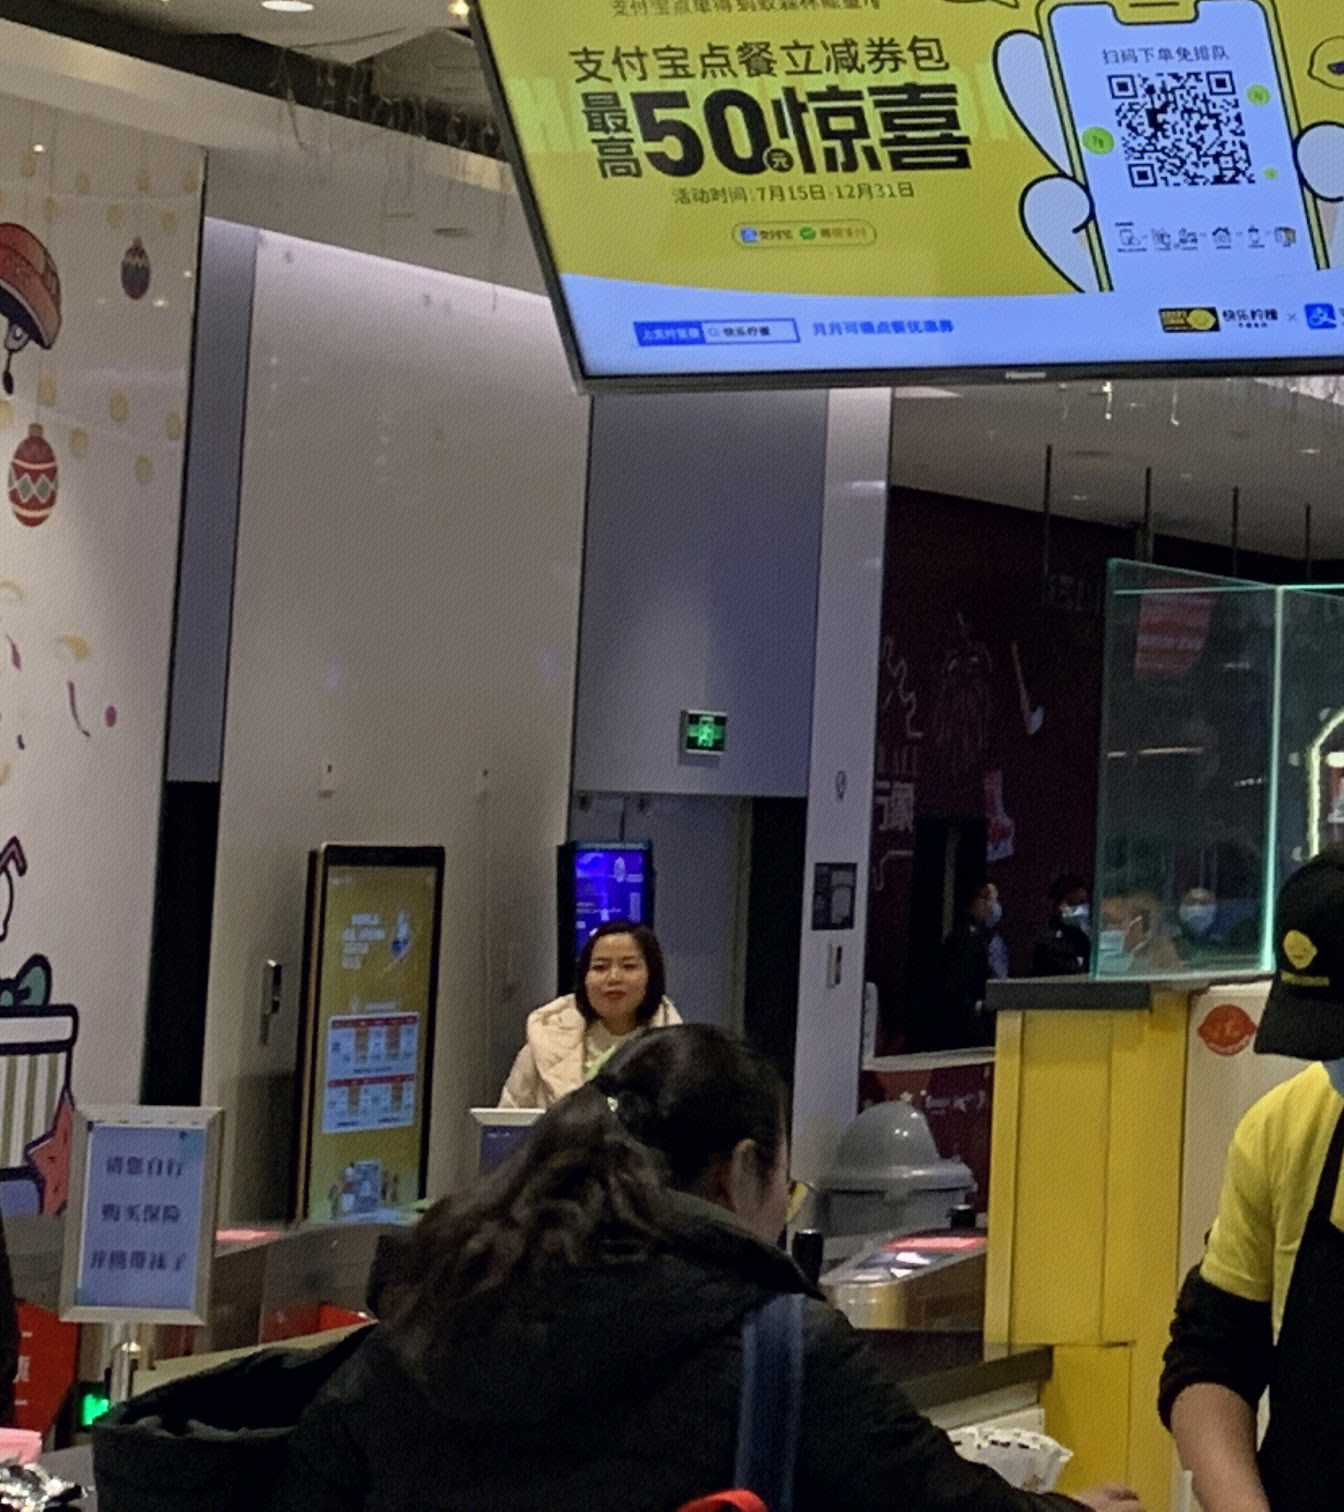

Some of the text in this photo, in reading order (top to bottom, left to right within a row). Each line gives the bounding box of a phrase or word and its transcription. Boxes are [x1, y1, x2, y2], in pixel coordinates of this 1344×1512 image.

[569, 35, 951, 83] 支付宝点餐立减券包
[1102, 44, 1230, 65] 扫码下单免排队
